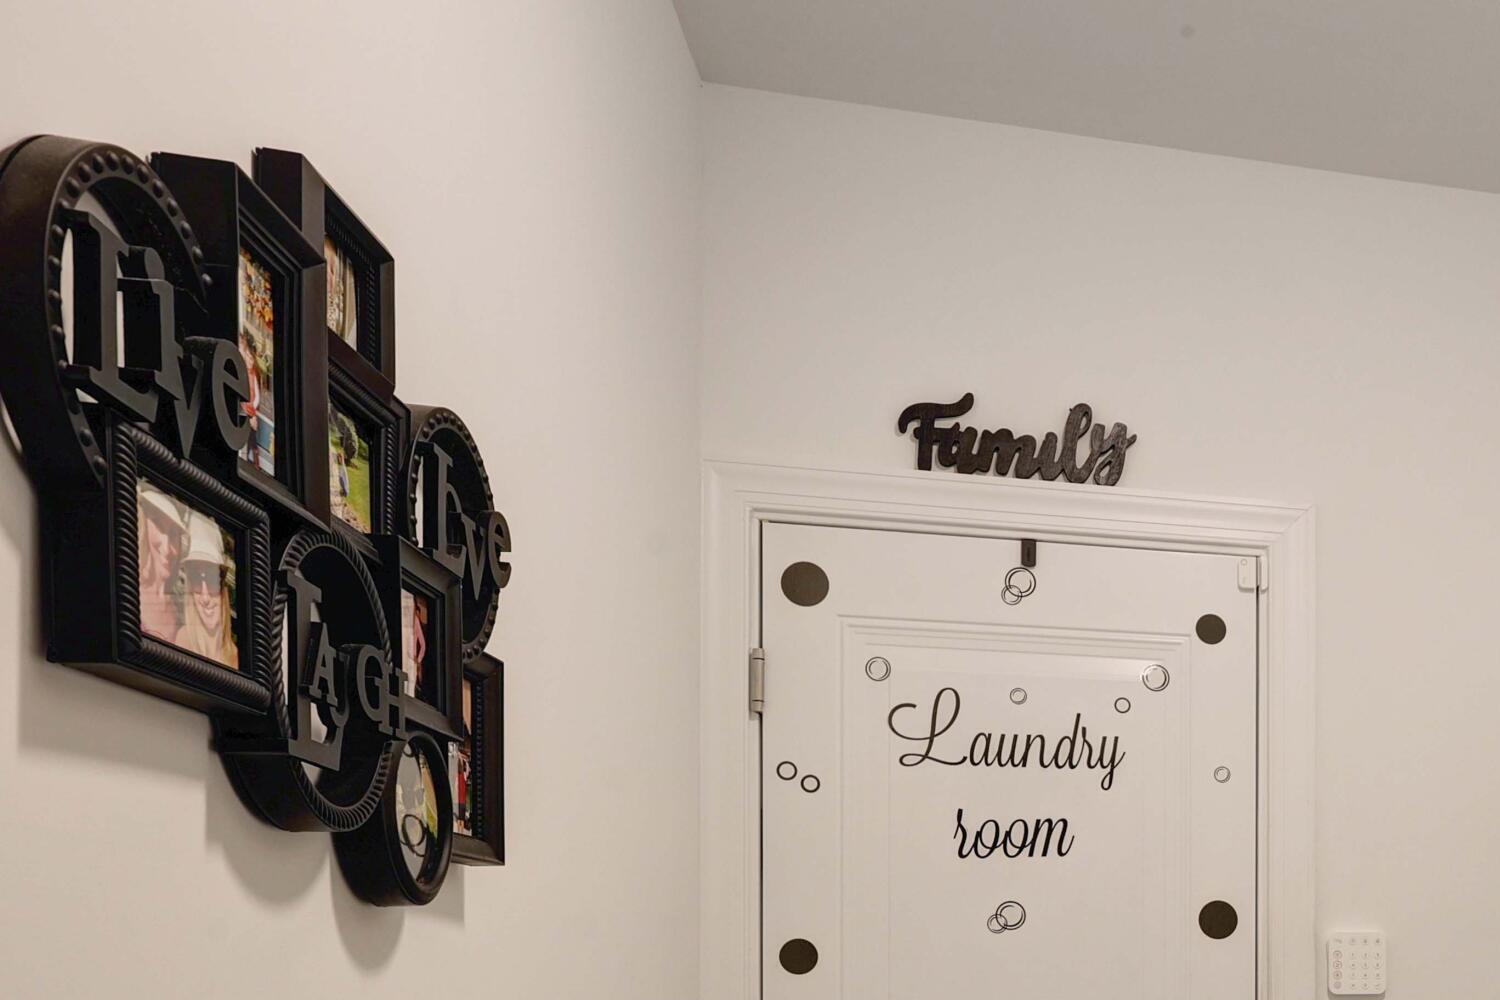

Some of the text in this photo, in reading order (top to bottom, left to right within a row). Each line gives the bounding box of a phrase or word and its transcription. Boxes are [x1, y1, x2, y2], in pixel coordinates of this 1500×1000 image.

[896, 391, 1138, 487] Family
[887, 687, 1125, 791] Laundry
[953, 808, 1075, 859] room
